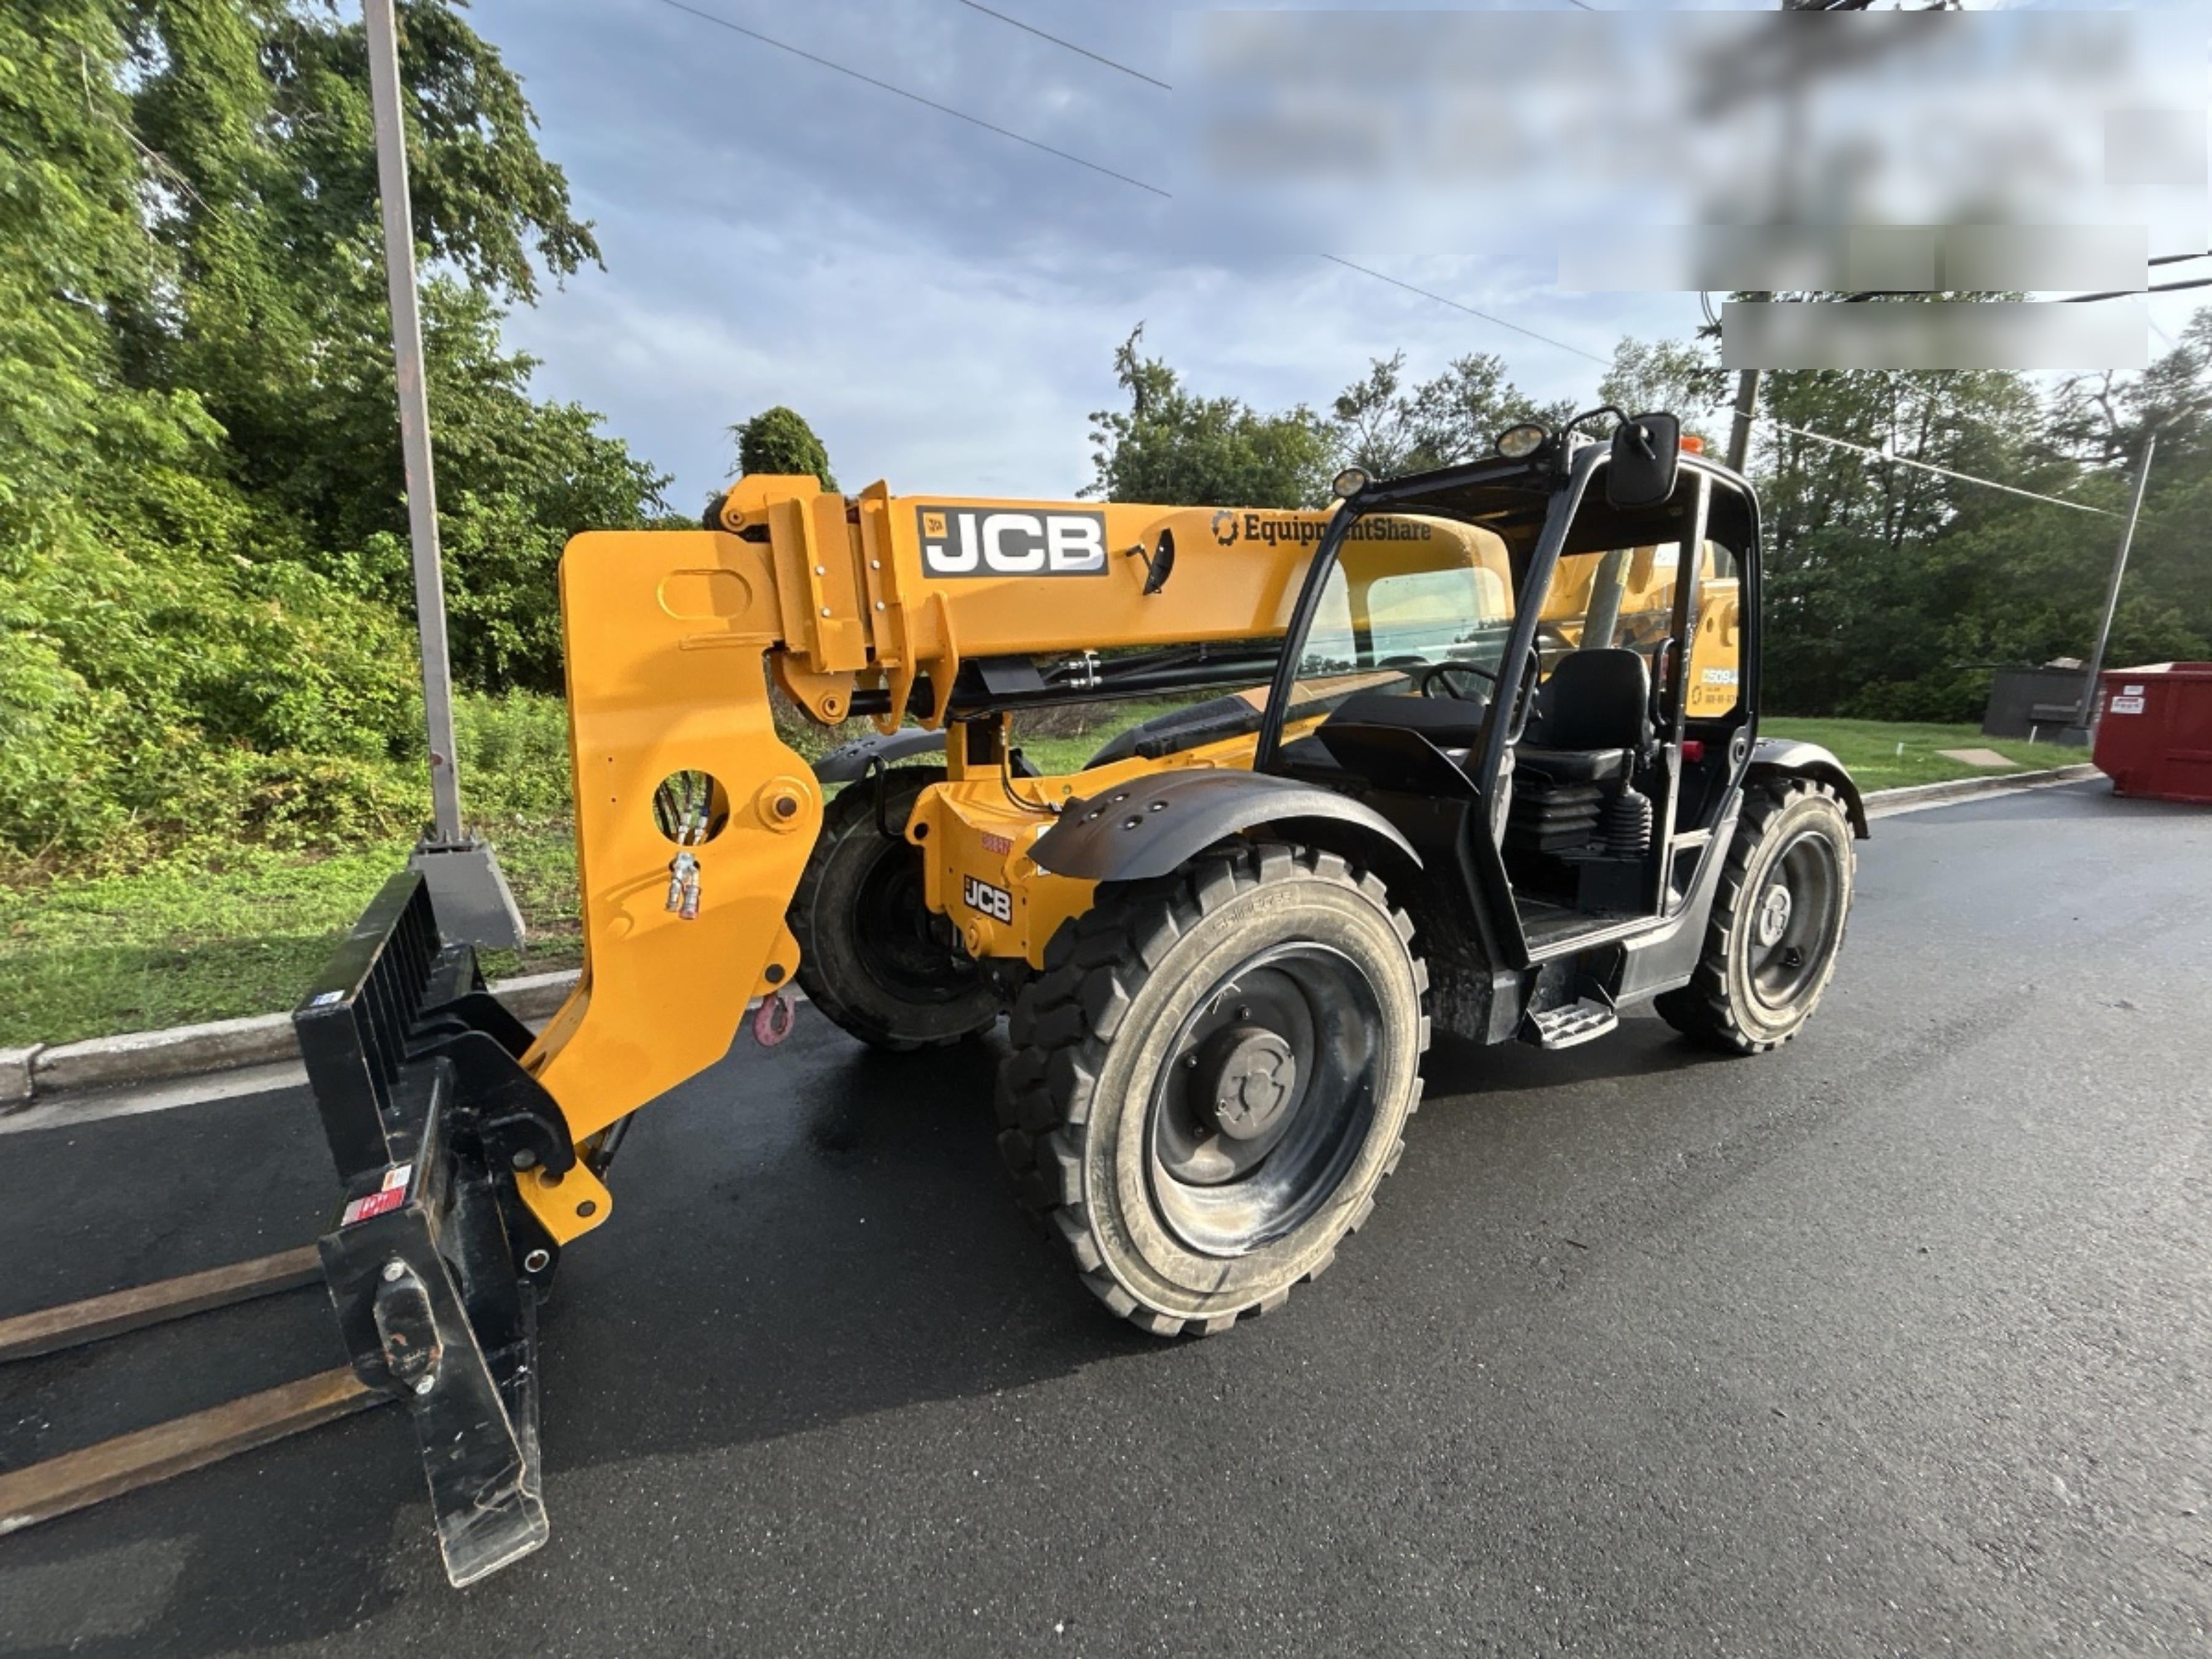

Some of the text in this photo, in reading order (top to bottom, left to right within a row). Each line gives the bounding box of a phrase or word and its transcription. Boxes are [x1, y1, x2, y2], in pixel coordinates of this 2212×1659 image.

[926, 514, 1105, 572] JCB
[1243, 514, 1432, 546] EquipntShare
[965, 880, 1011, 922] JCB
